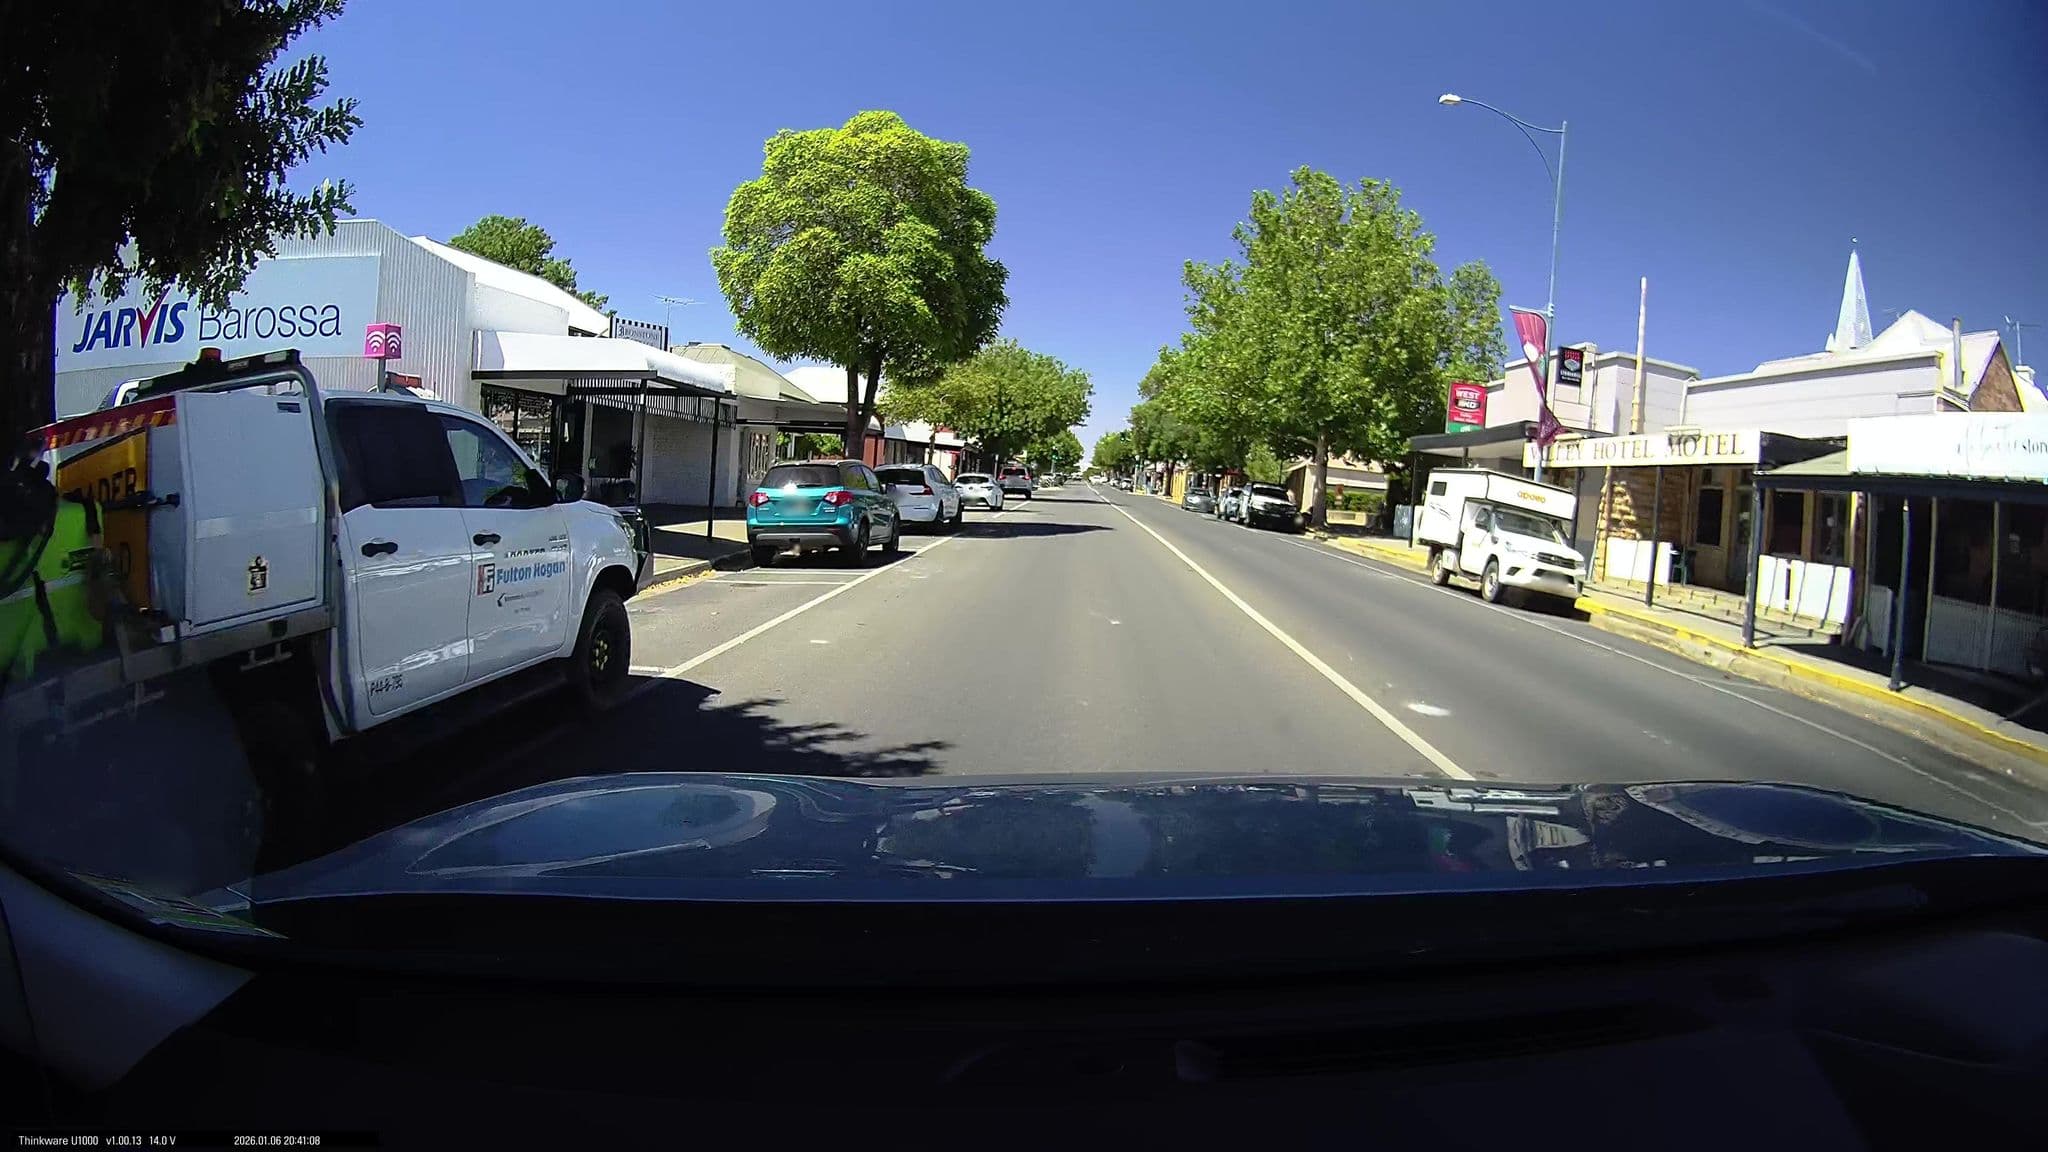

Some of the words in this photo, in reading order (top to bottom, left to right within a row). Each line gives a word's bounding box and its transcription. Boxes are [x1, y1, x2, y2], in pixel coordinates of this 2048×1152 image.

[72, 287, 188, 352] JARVIS
[199, 303, 342, 341] Barossa
[1455, 390, 1480, 400] WEST
[1593, 438, 1655, 460] HOTEL
[1665, 433, 1745, 458] MOTEL
[496, 566, 532, 585] Fulton
[533, 561, 566, 578] Hogan
